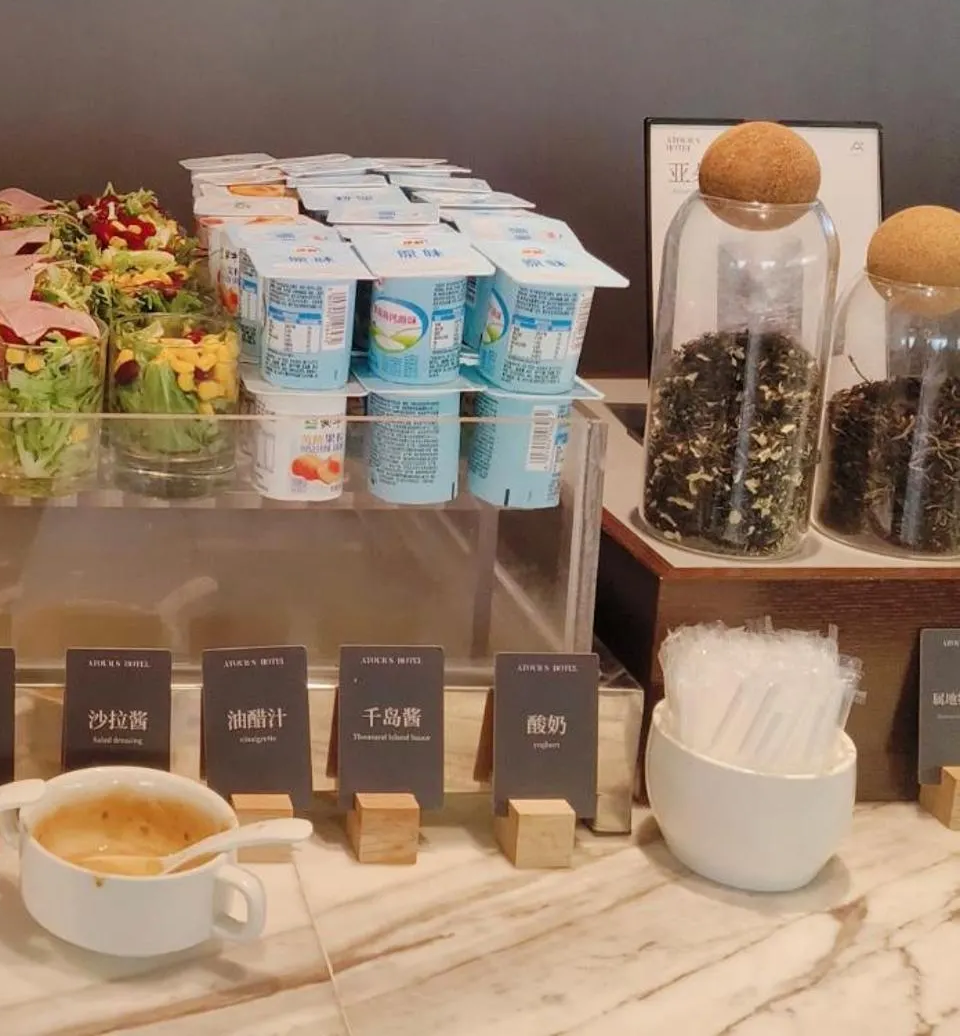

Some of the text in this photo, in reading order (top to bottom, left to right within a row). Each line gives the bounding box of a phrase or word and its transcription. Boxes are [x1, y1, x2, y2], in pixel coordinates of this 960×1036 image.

[668, 161, 700, 183] 亚
[88, 709, 148, 731] 沙拉酱
[227, 707, 287, 731] 油醋汁
[361, 706, 422, 727] 千岛酱
[527, 714, 567, 735] 酸奶
